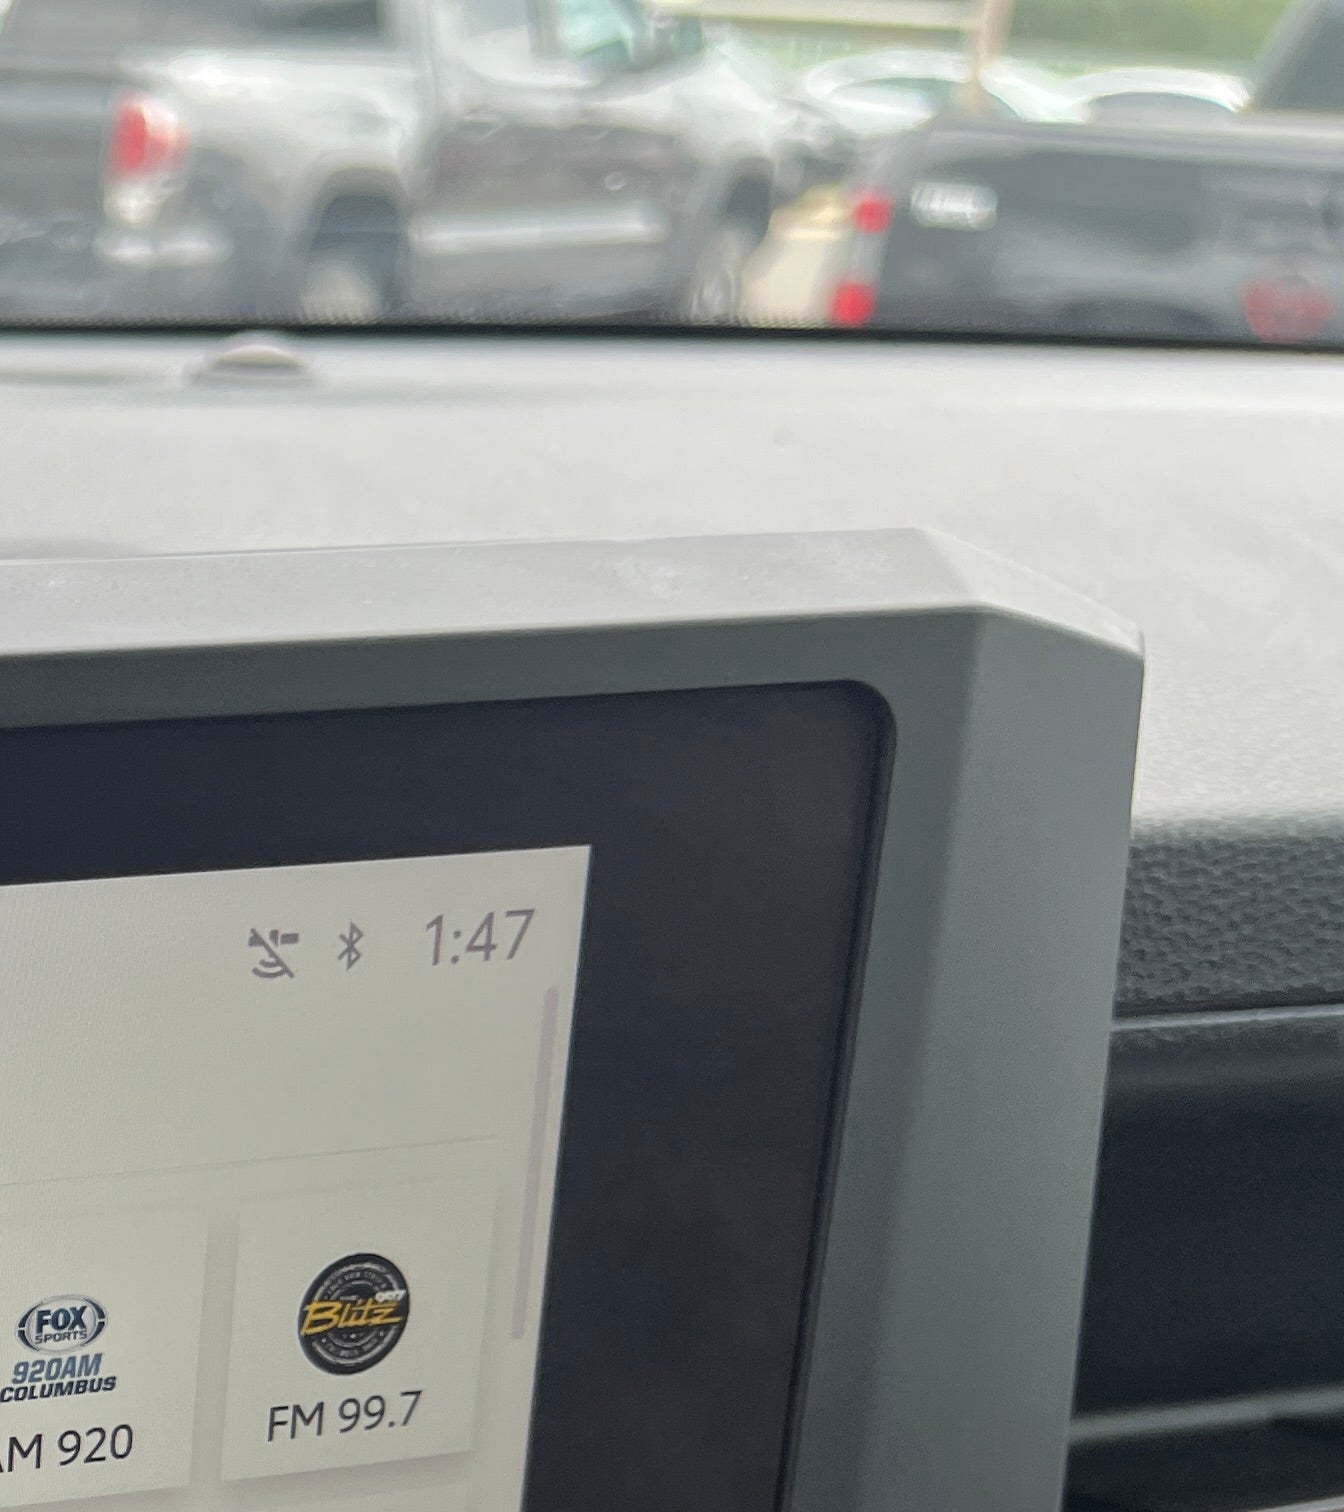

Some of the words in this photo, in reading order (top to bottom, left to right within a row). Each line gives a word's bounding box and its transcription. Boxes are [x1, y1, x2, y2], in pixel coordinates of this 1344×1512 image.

[427, 909, 535, 965] 1:47
[36, 1305, 88, 1334] FOX
[300, 1297, 402, 1336] Blitz
[34, 1330, 88, 1344] SPORTS
[11, 1353, 103, 1385] 920AM
[267, 1401, 325, 1442] FM
[337, 1390, 423, 1434] 99.7
[57, 1423, 134, 1467] 920
